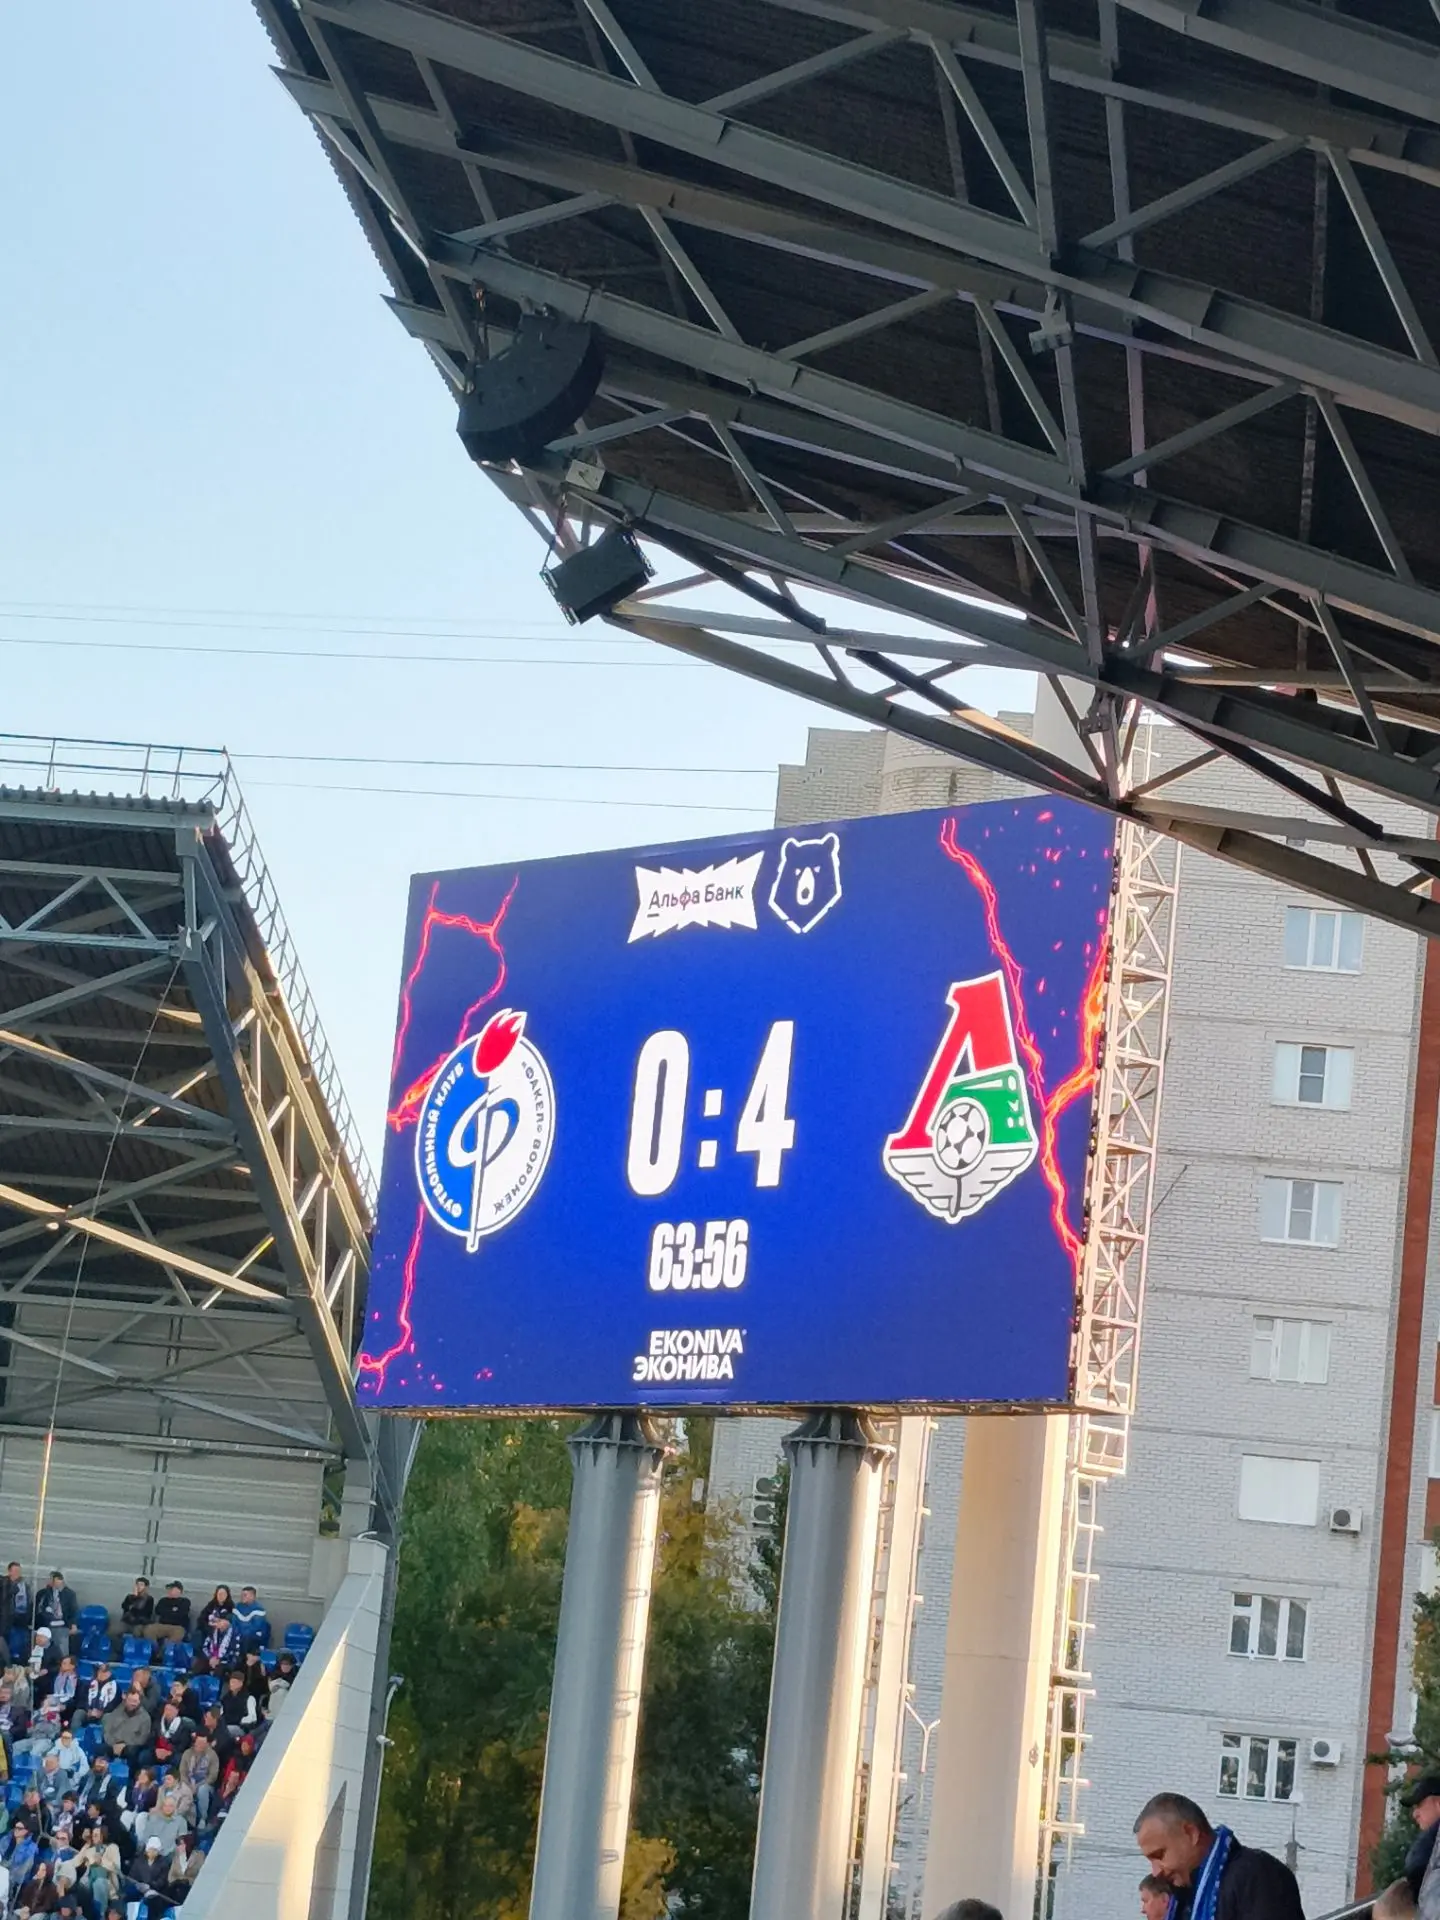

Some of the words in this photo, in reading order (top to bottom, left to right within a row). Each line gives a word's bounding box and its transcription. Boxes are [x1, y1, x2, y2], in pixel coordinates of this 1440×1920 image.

[648, 887, 700, 915] Альфа
[704, 883, 744, 903] Банк
[493, 1139, 542, 1215] ВОРОНЕЖ
[649, 1219, 749, 1291] 63:56
[649, 1329, 744, 1355] EKONIVA
[632, 1354, 734, 1381] ЭКОНИВА
